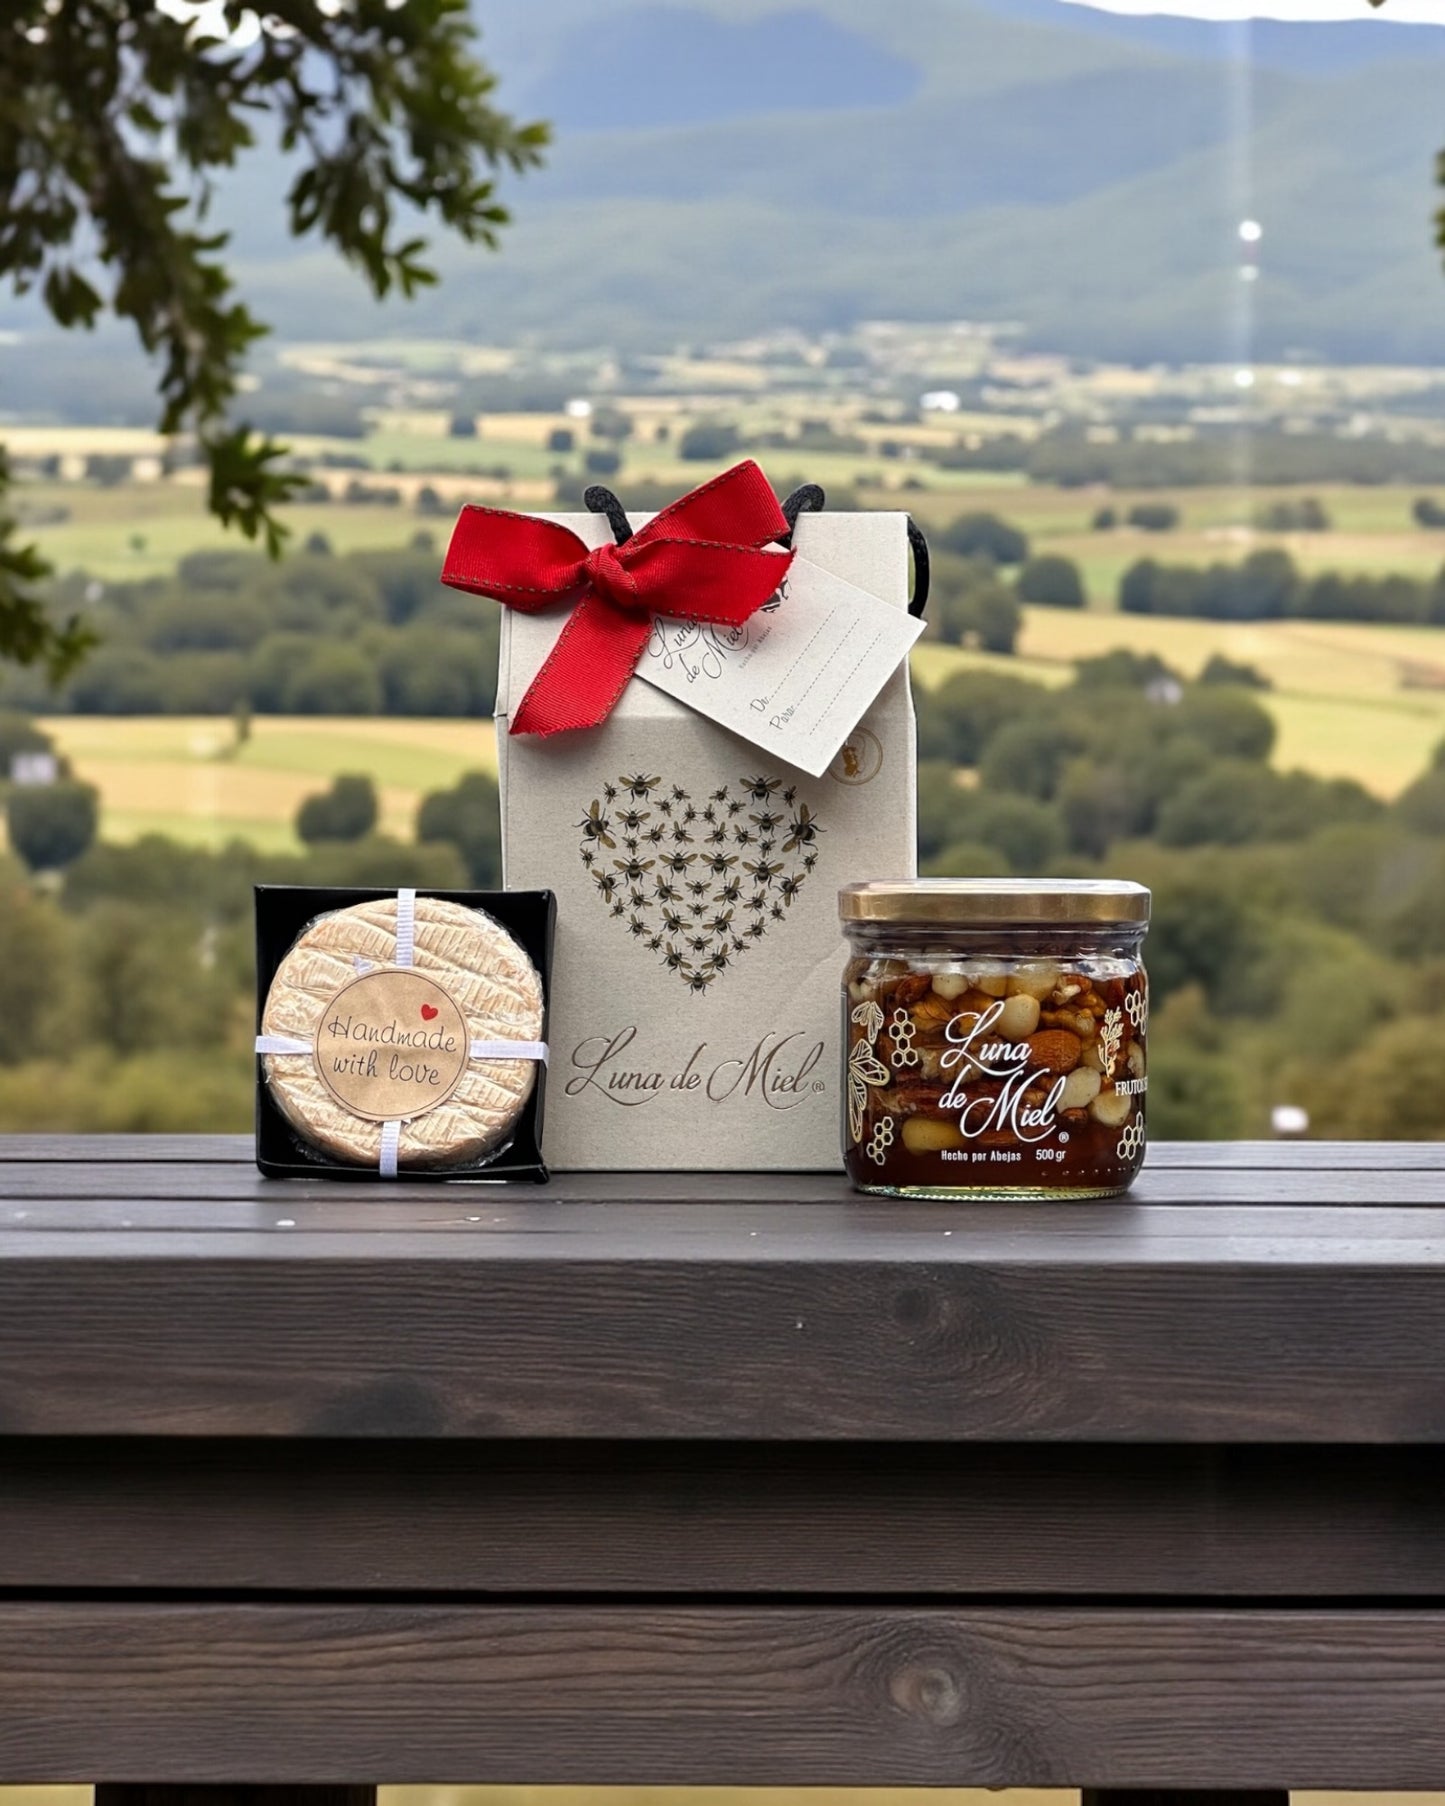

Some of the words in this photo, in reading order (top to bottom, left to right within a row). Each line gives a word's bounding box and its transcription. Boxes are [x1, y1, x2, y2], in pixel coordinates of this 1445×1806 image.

[678, 653, 700, 683] de
[328, 1016, 457, 1053] Handmade
[940, 1000, 1032, 1076] Luna
[333, 1050, 378, 1078] with
[389, 1054, 441, 1086] love
[565, 1026, 665, 1106] Luna
[670, 1042, 708, 1090] de
[938, 1064, 972, 1109] de
[941, 1150, 968, 1161] Hecho
[972, 1151, 987, 1163] por
[990, 1150, 1022, 1163] Abejas
